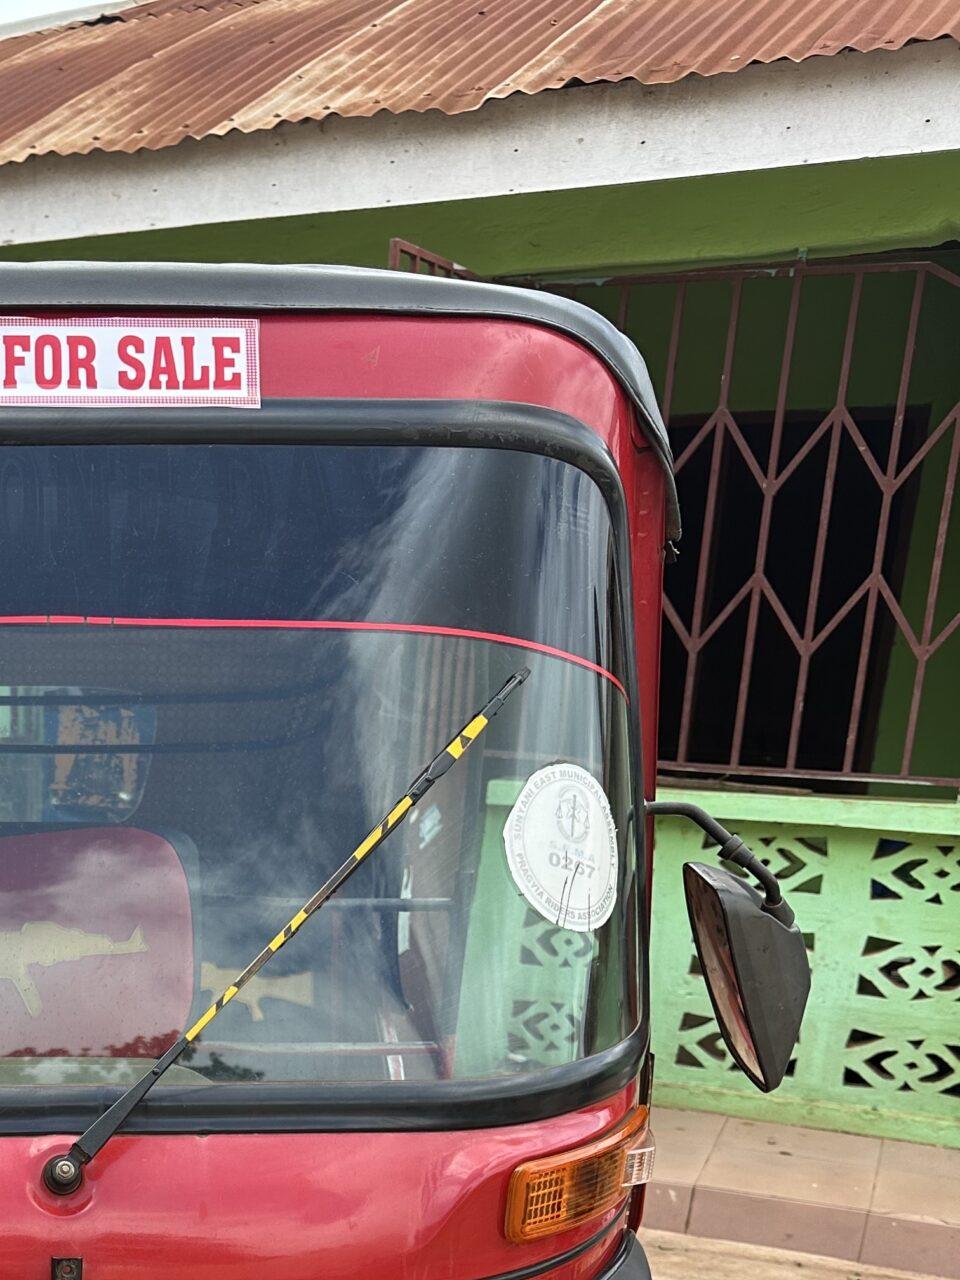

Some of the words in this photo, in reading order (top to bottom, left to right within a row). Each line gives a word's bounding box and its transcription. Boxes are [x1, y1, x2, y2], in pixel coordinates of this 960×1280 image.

[3, 334, 97, 389] FOR
[117, 335, 241, 390] SALE
[513, 789, 535, 841] SUNYANI
[534, 770, 558, 790] EAST
[559, 769, 602, 801] MUNICIPAL
[544, 894, 576, 920] RIDERS
[577, 885, 614, 921] ASSOCIATION
